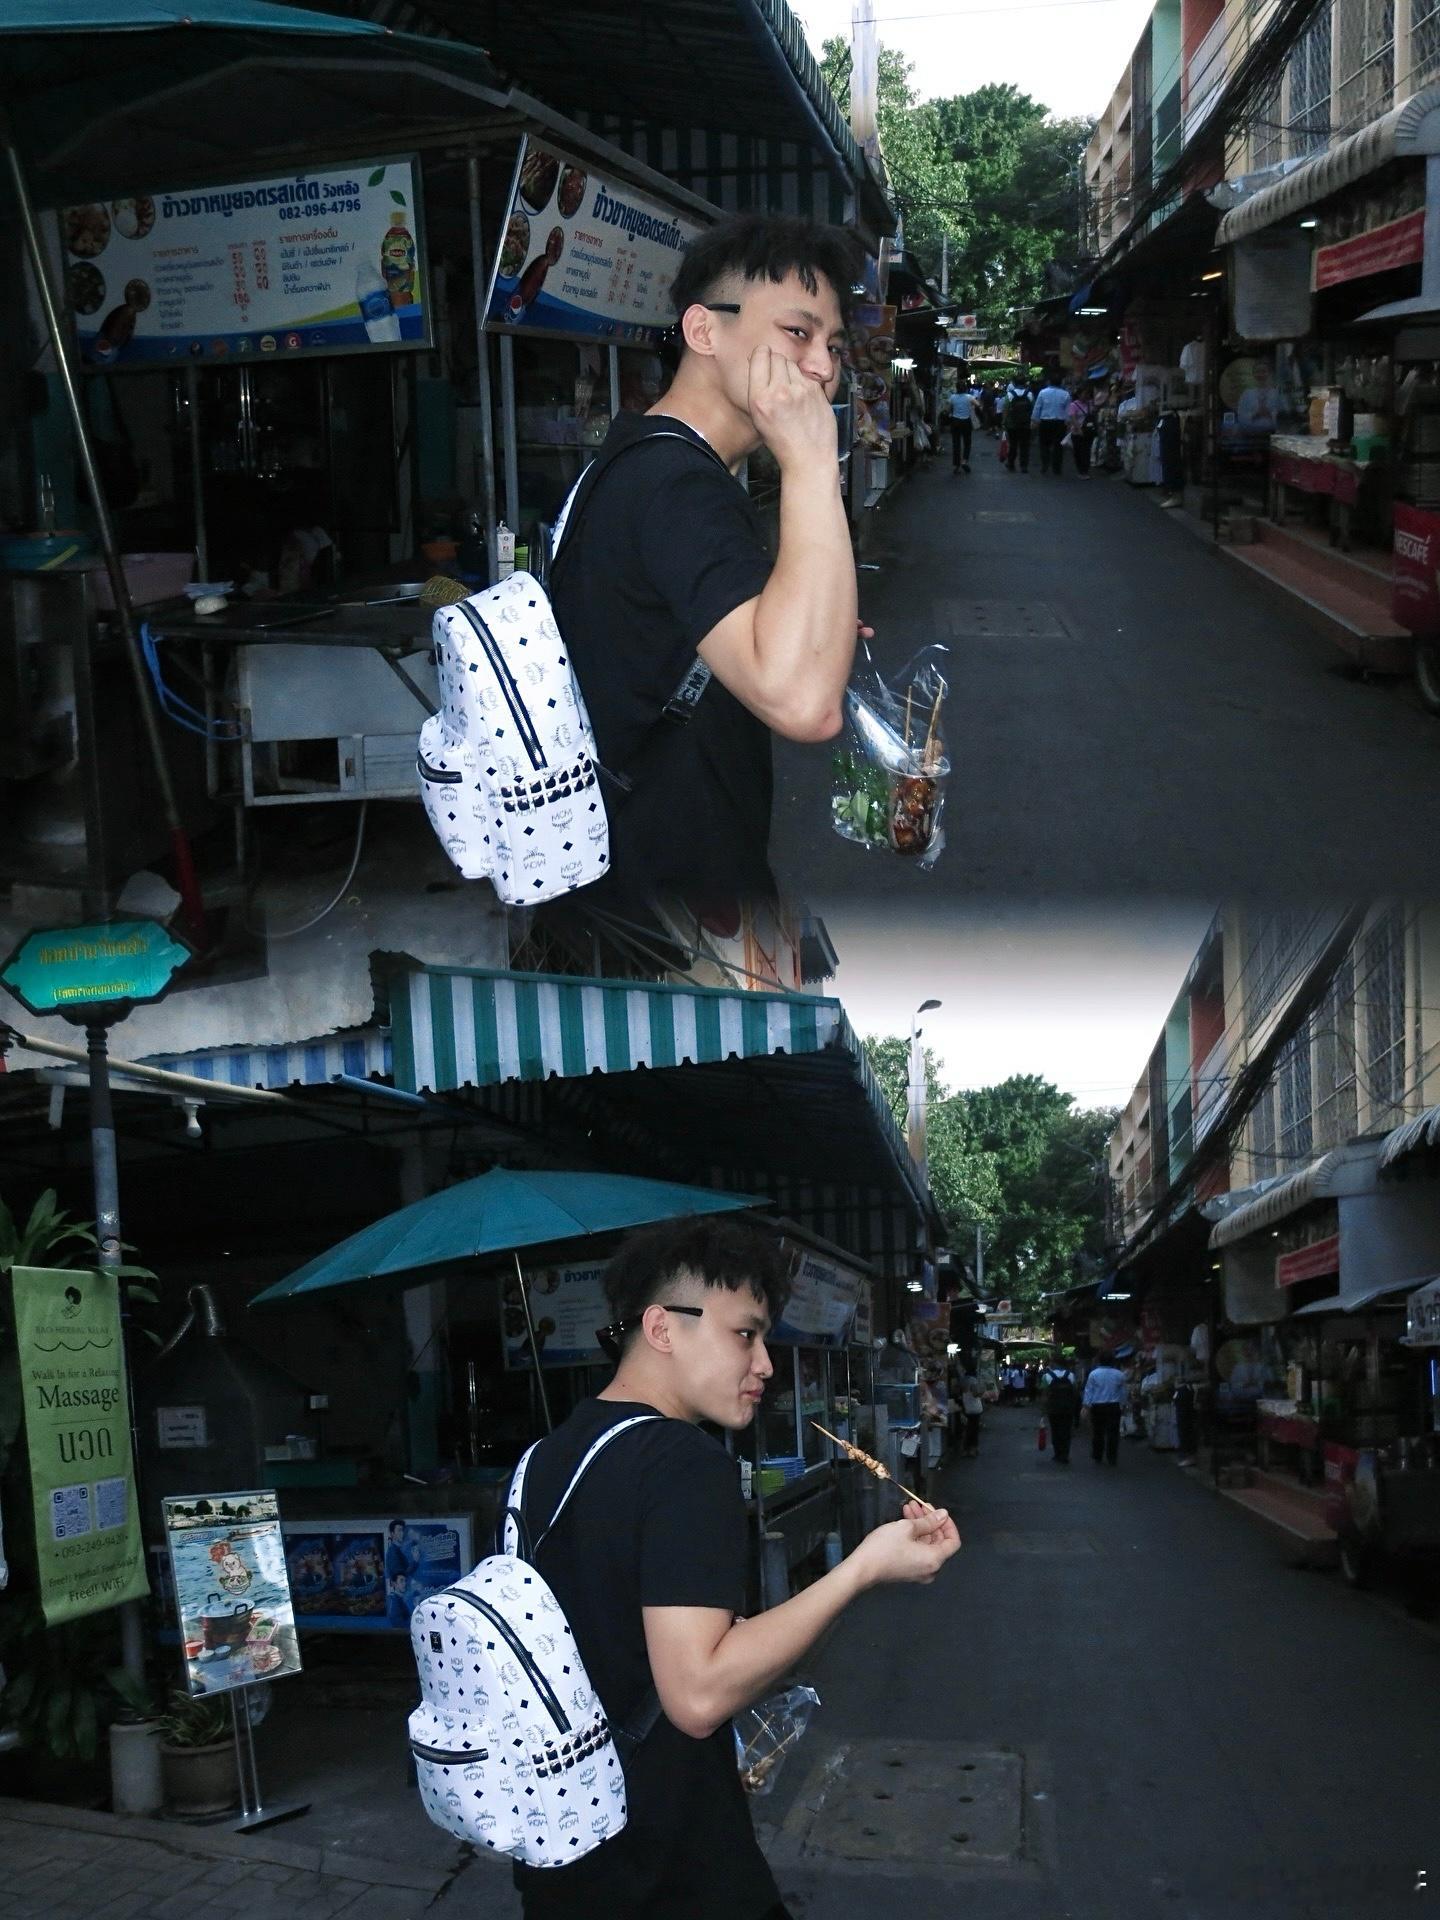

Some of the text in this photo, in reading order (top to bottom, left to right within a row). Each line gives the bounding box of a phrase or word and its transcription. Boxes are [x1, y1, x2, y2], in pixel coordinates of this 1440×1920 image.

[162, 178, 361, 219] ข้าวขาหมูยอดรสเด็ด วังหลัง
[279, 199, 362, 220] 082-096-4796
[592, 185, 681, 250] ข้าวขาหมูยอดรสเด็ด
[279, 226, 338, 244] รายการเครื่องดื่ม
[552, 808, 573, 822] MCM
[523, 859, 546, 870] MCM
[560, 860, 583, 873] MCM
[37, 1384, 120, 1412] Massage
[58, 1427, 113, 1463] นวด
[69, 1583, 98, 1602] Free!!
[464, 1771, 485, 1782] MCM
[579, 1766, 598, 1781] MCM
[476, 1819, 497, 1832] MCM
[559, 1816, 580, 1831] MCM
[591, 1814, 609, 1829] MCM
